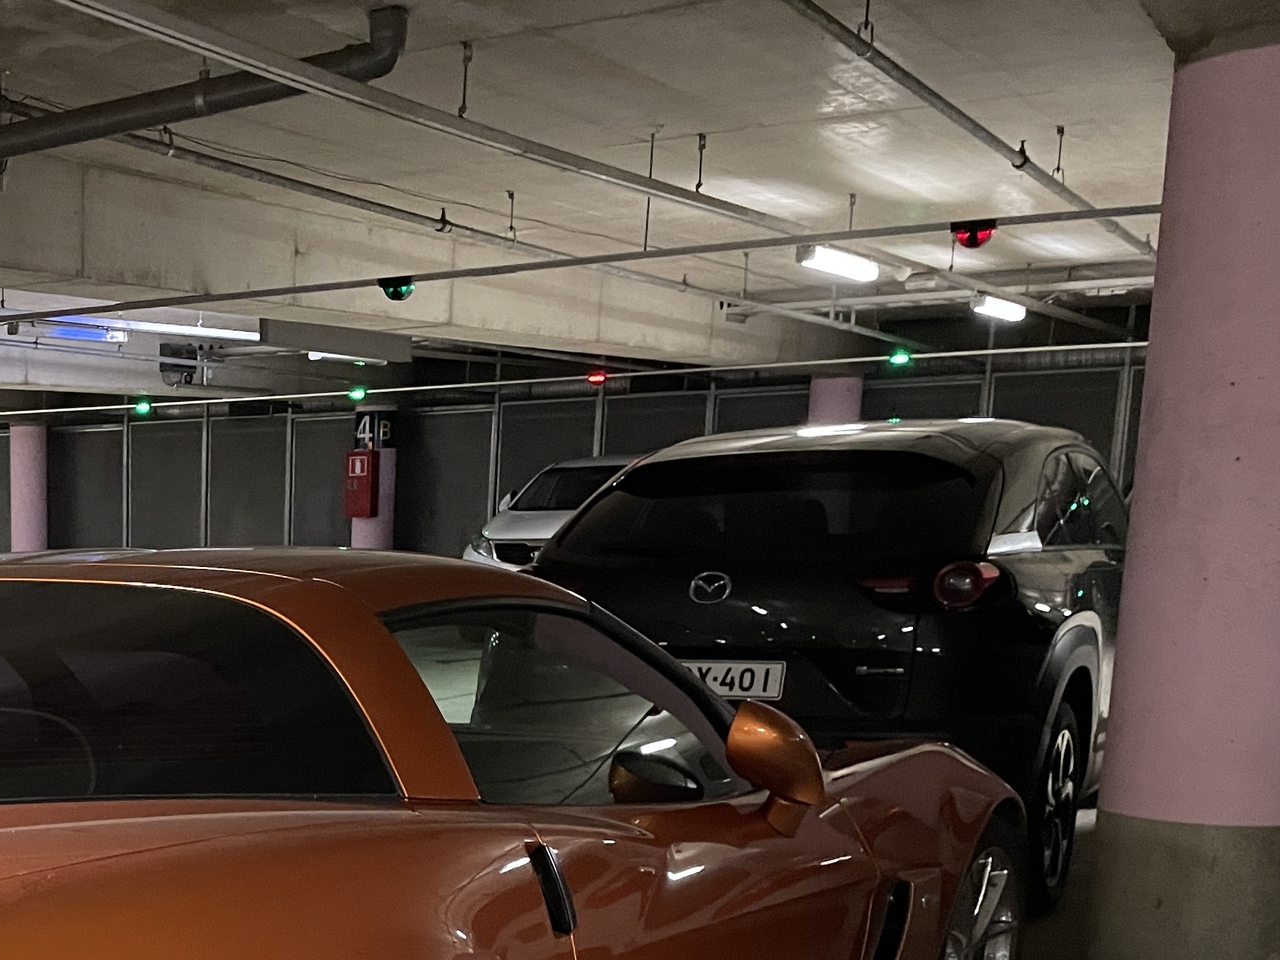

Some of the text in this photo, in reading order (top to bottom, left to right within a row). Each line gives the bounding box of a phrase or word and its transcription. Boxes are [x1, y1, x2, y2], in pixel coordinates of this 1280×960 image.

[356, 415, 392, 445] 4 B
[687, 664, 771, 692] Y-401
